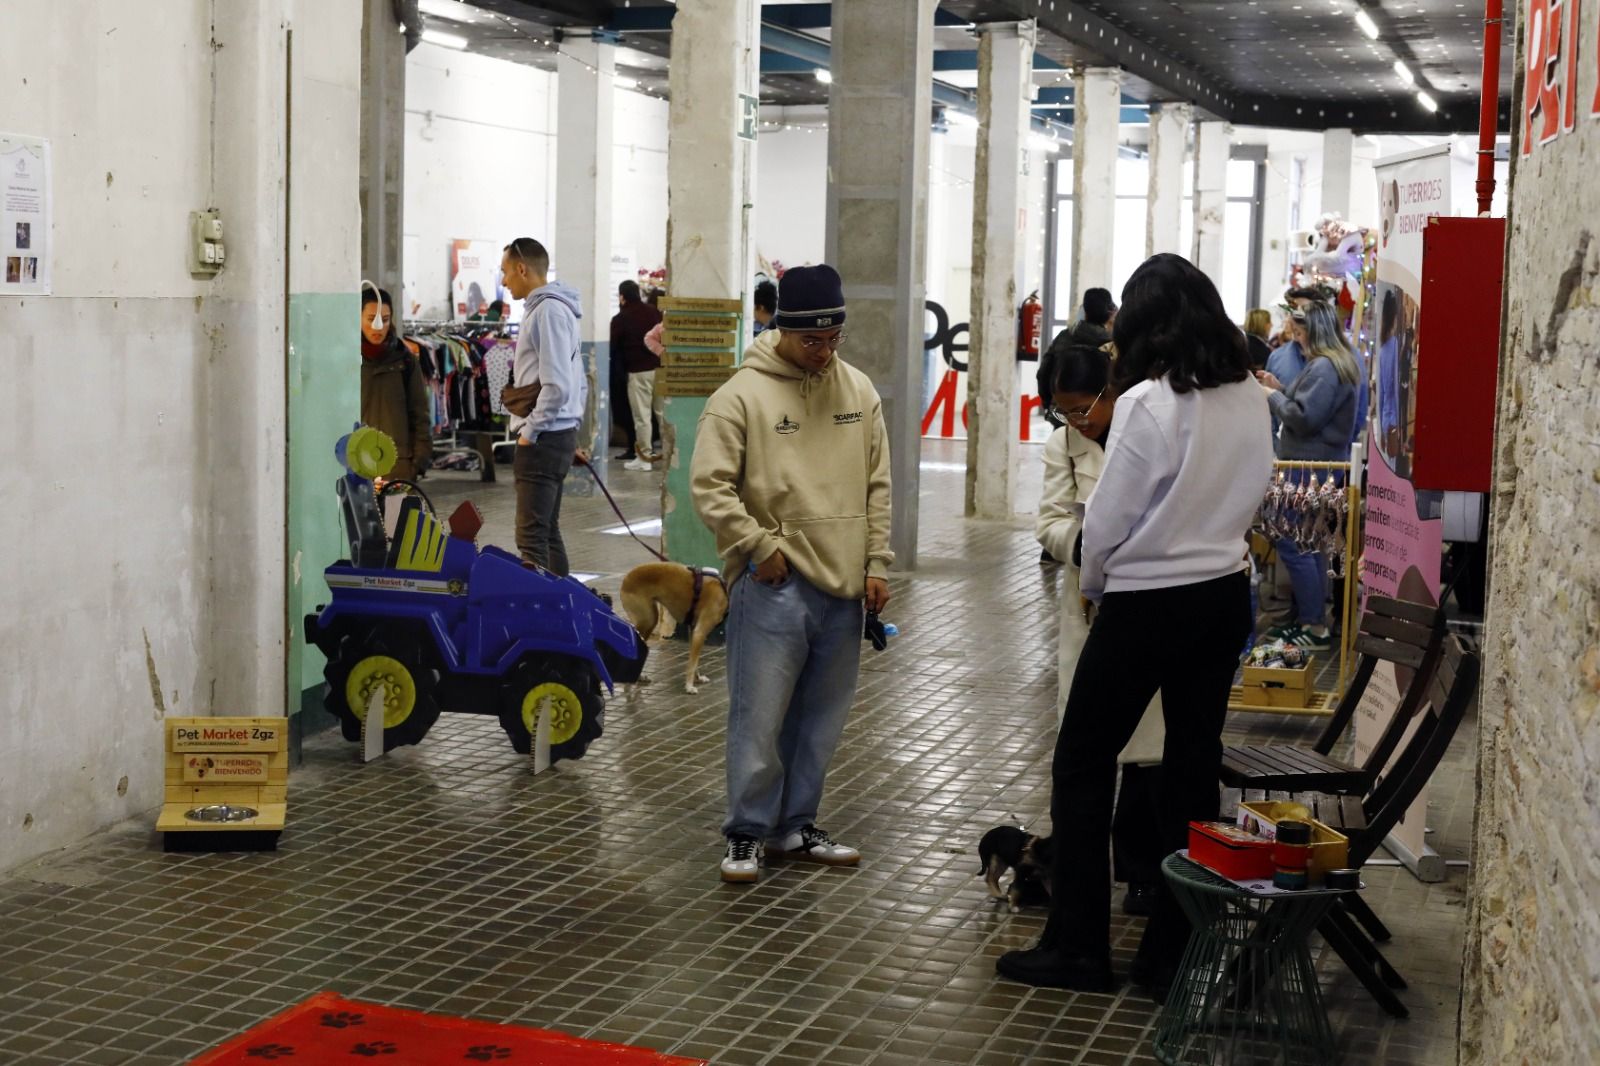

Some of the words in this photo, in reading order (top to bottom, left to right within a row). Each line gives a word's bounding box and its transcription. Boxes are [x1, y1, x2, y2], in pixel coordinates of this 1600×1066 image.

[1366, 505, 1391, 526] dmiten
[1364, 534, 1385, 551] erros
[1364, 559, 1389, 578] ompras
[377, 577, 401, 586] Market
[177, 728, 199, 740] Pet
[203, 728, 249, 740] Market
[252, 728, 274, 742] Zgz
